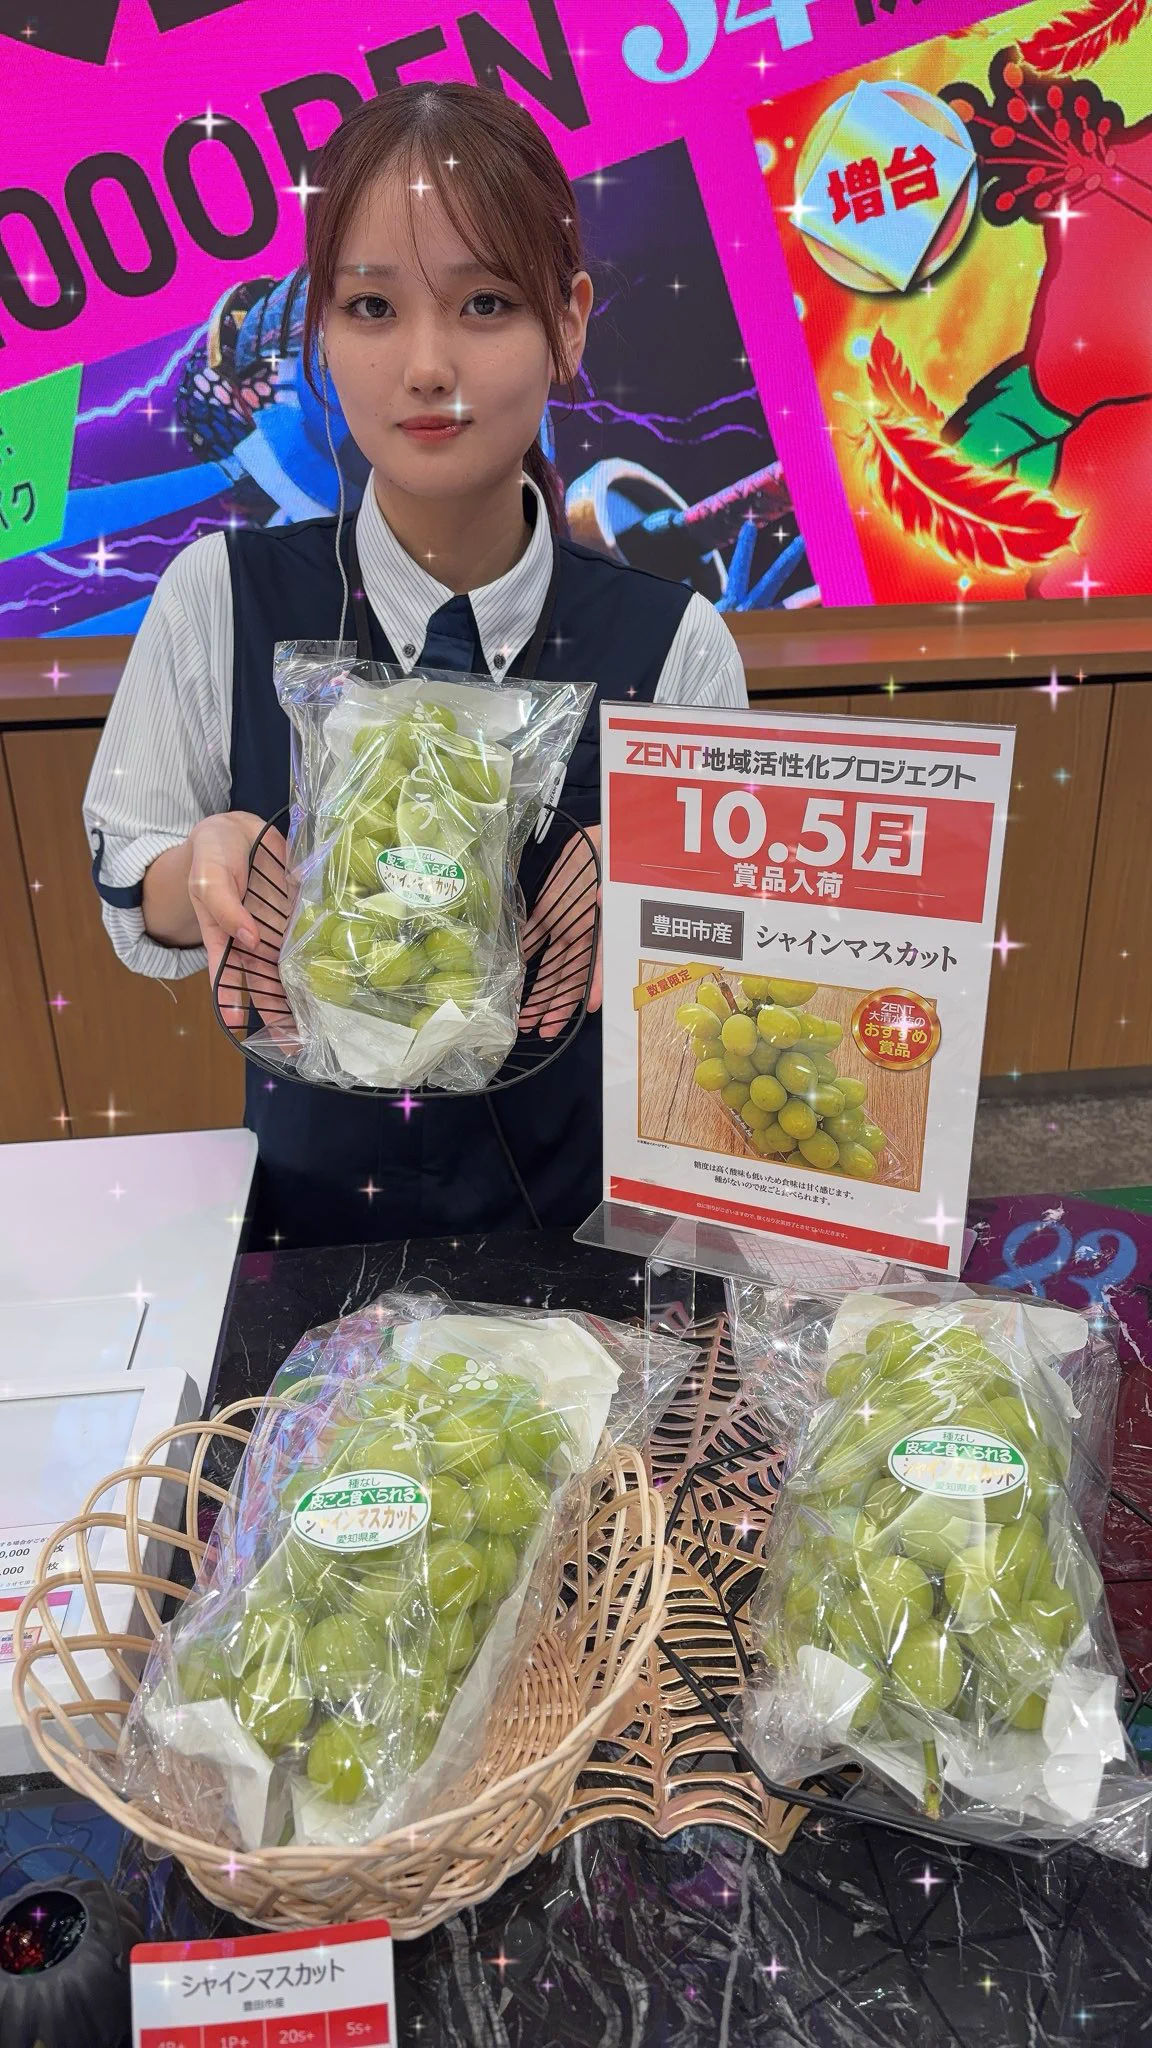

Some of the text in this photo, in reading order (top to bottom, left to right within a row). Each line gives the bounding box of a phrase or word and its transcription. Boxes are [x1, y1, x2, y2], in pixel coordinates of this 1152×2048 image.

[827, 144, 941, 225] 増台
[625, 740, 977, 790] ZENT地域活性化プロジェクト
[732, 862, 844, 900] 賞品入荷
[651, 914, 958, 974] 豊田市産 シャインマスカット
[645, 968, 692, 998] 数量限定
[880, 1001, 916, 1015] ZENT
[864, 1022, 928, 1044] おすすめ
[878, 1040, 911, 1059] 賞品
[942, 1431, 976, 1443] 種なし
[904, 1441, 1013, 1464] 皮ごと食べられる
[349, 1477, 381, 1489] 種なし
[309, 1487, 417, 1511] 皮ごと食べられる
[336, 1532, 380, 1545] 愛知県産
[181, 1958, 345, 1998] シャインマスカット
[278, 2027, 315, 2045] 20s+
